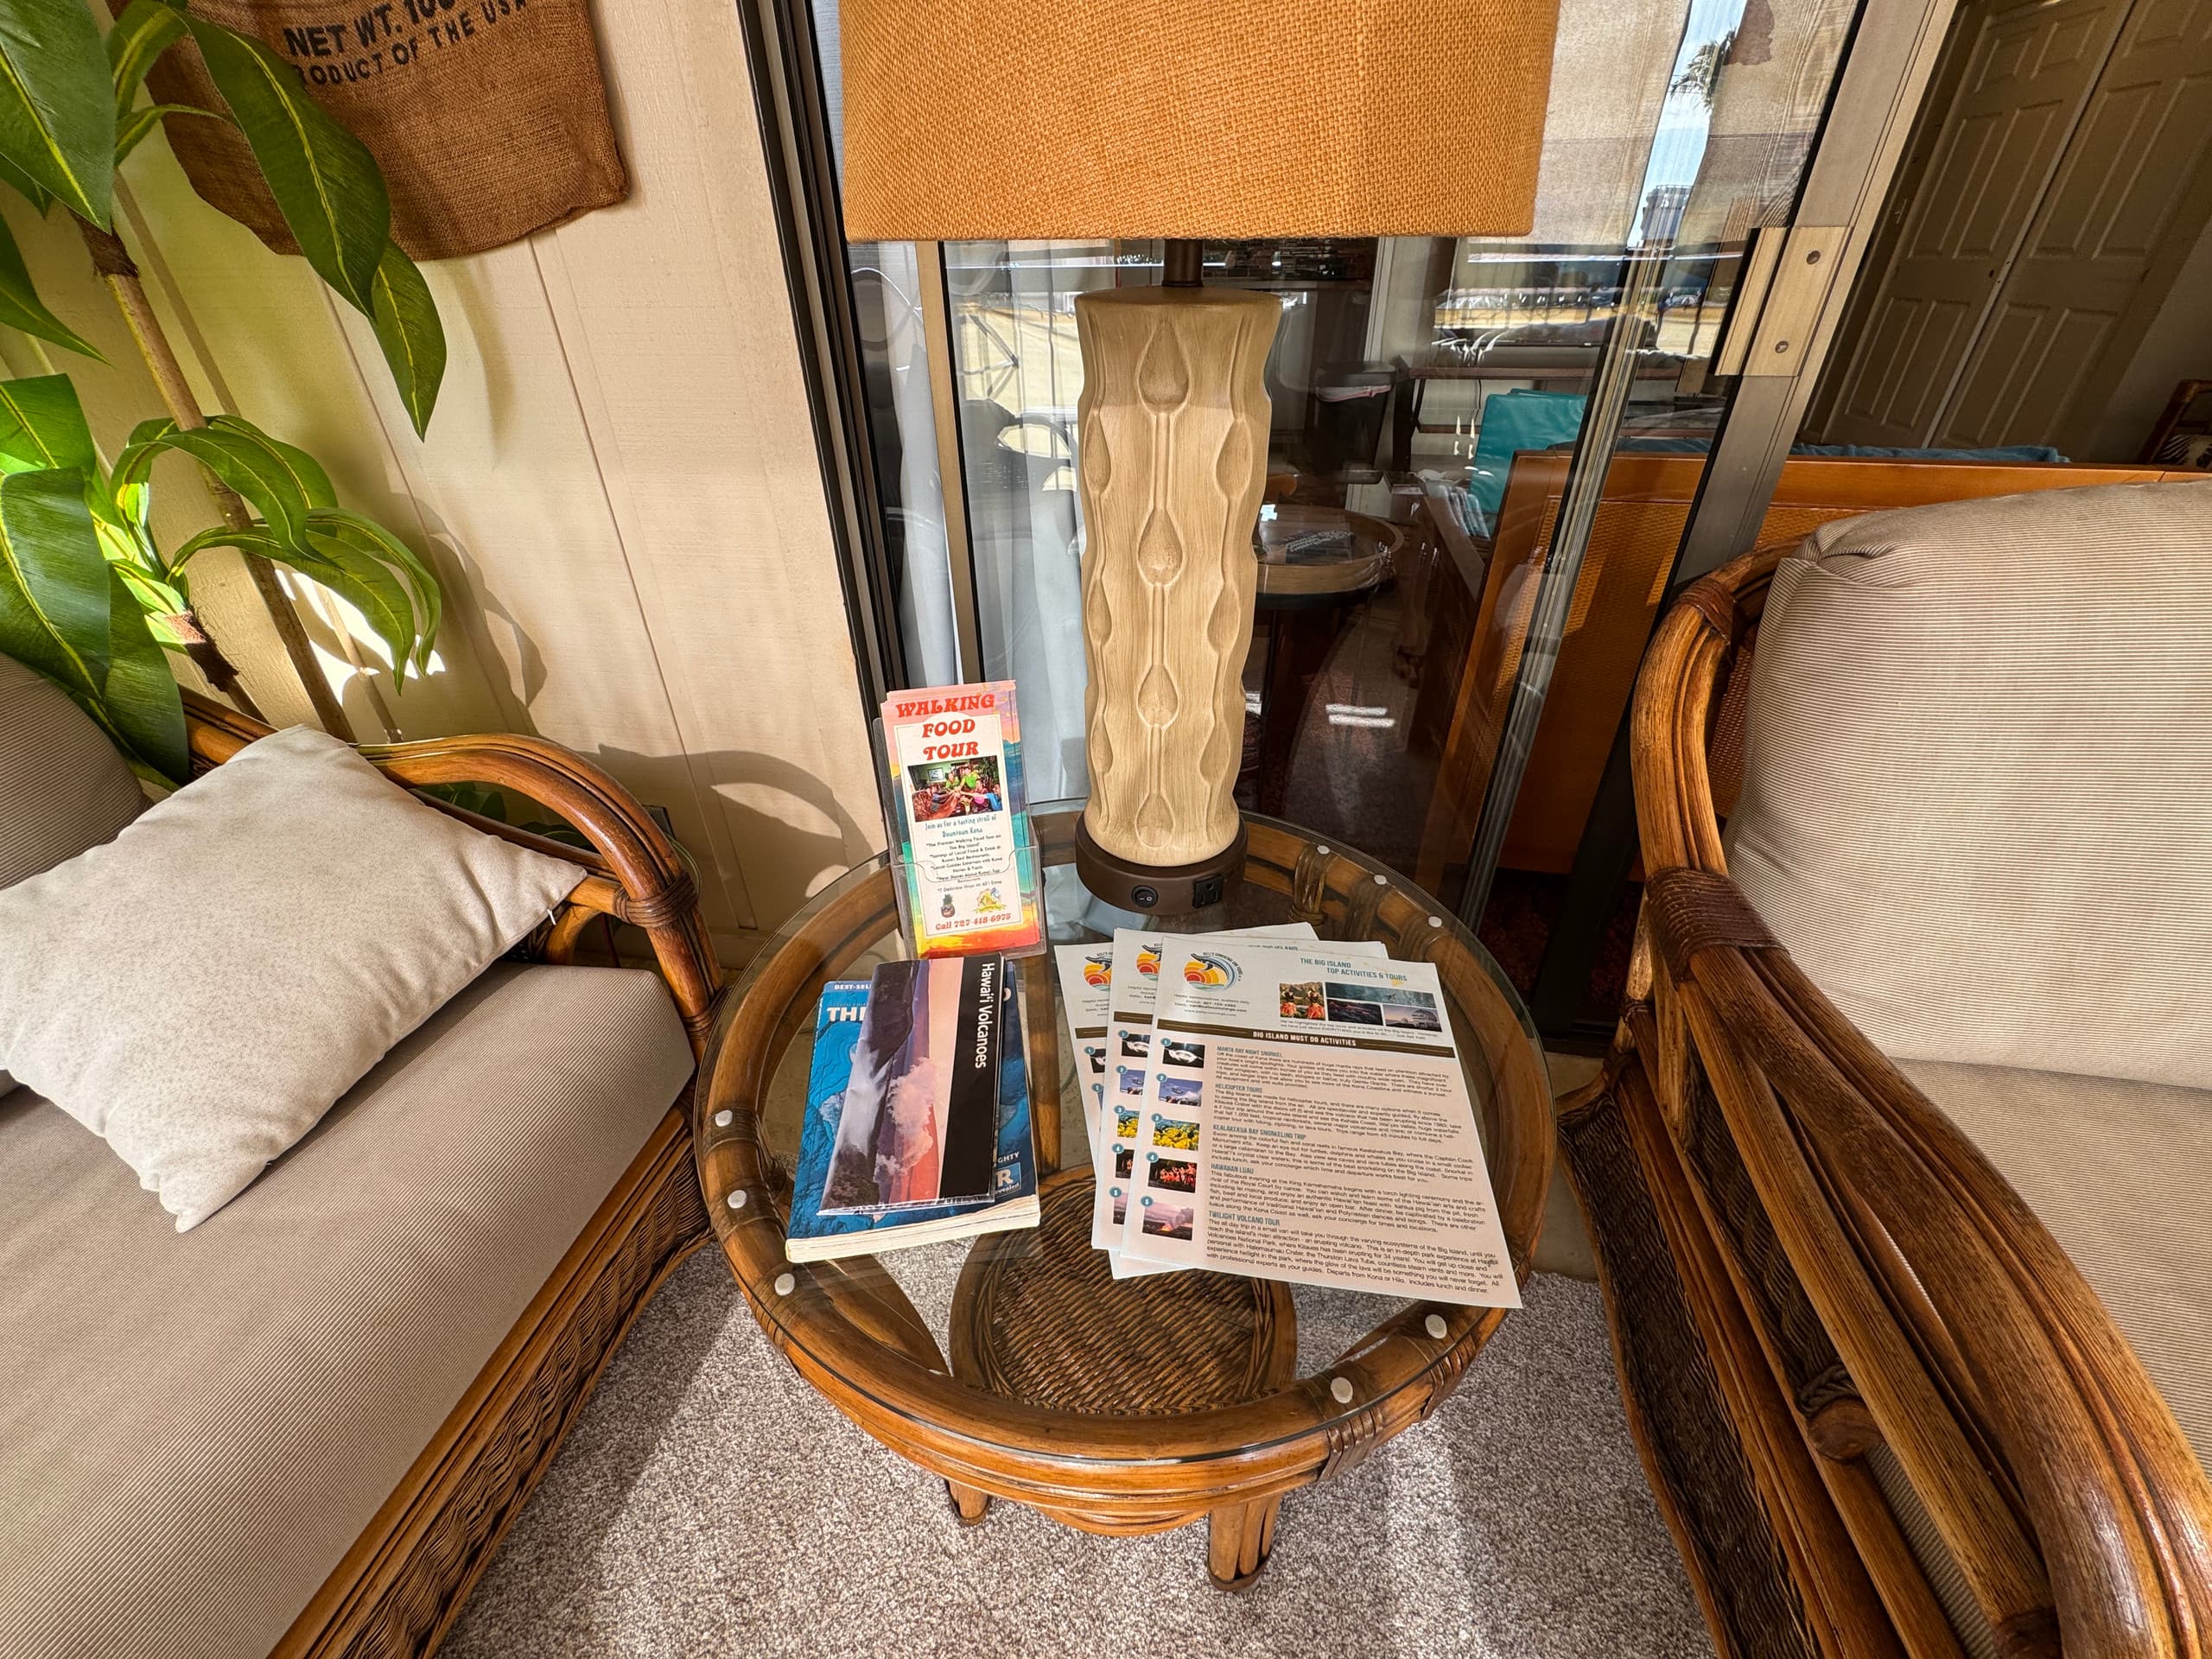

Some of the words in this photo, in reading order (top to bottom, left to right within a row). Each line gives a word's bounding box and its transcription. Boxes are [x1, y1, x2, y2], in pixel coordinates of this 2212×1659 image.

[283, 24, 346, 56] NET
[354, 4, 403, 47] WT.
[391, 36, 418, 66] OF
[428, 11, 475, 48] THE
[895, 694, 995, 718] WALKING
[922, 719, 976, 738] FOOD
[923, 741, 979, 760] TOUR
[977, 815, 990, 823] stroll
[1341, 969, 1377, 978] ACTIVITIES
[975, 1005, 993, 1069] Volcanoes
[1320, 1038, 1356, 1046] ACTIVITIES
[995, 1169, 1014, 1187] R
[1209, 1211, 1235, 1220] TWILIGHT
[1236, 1214, 1262, 1224] VOLCANO
